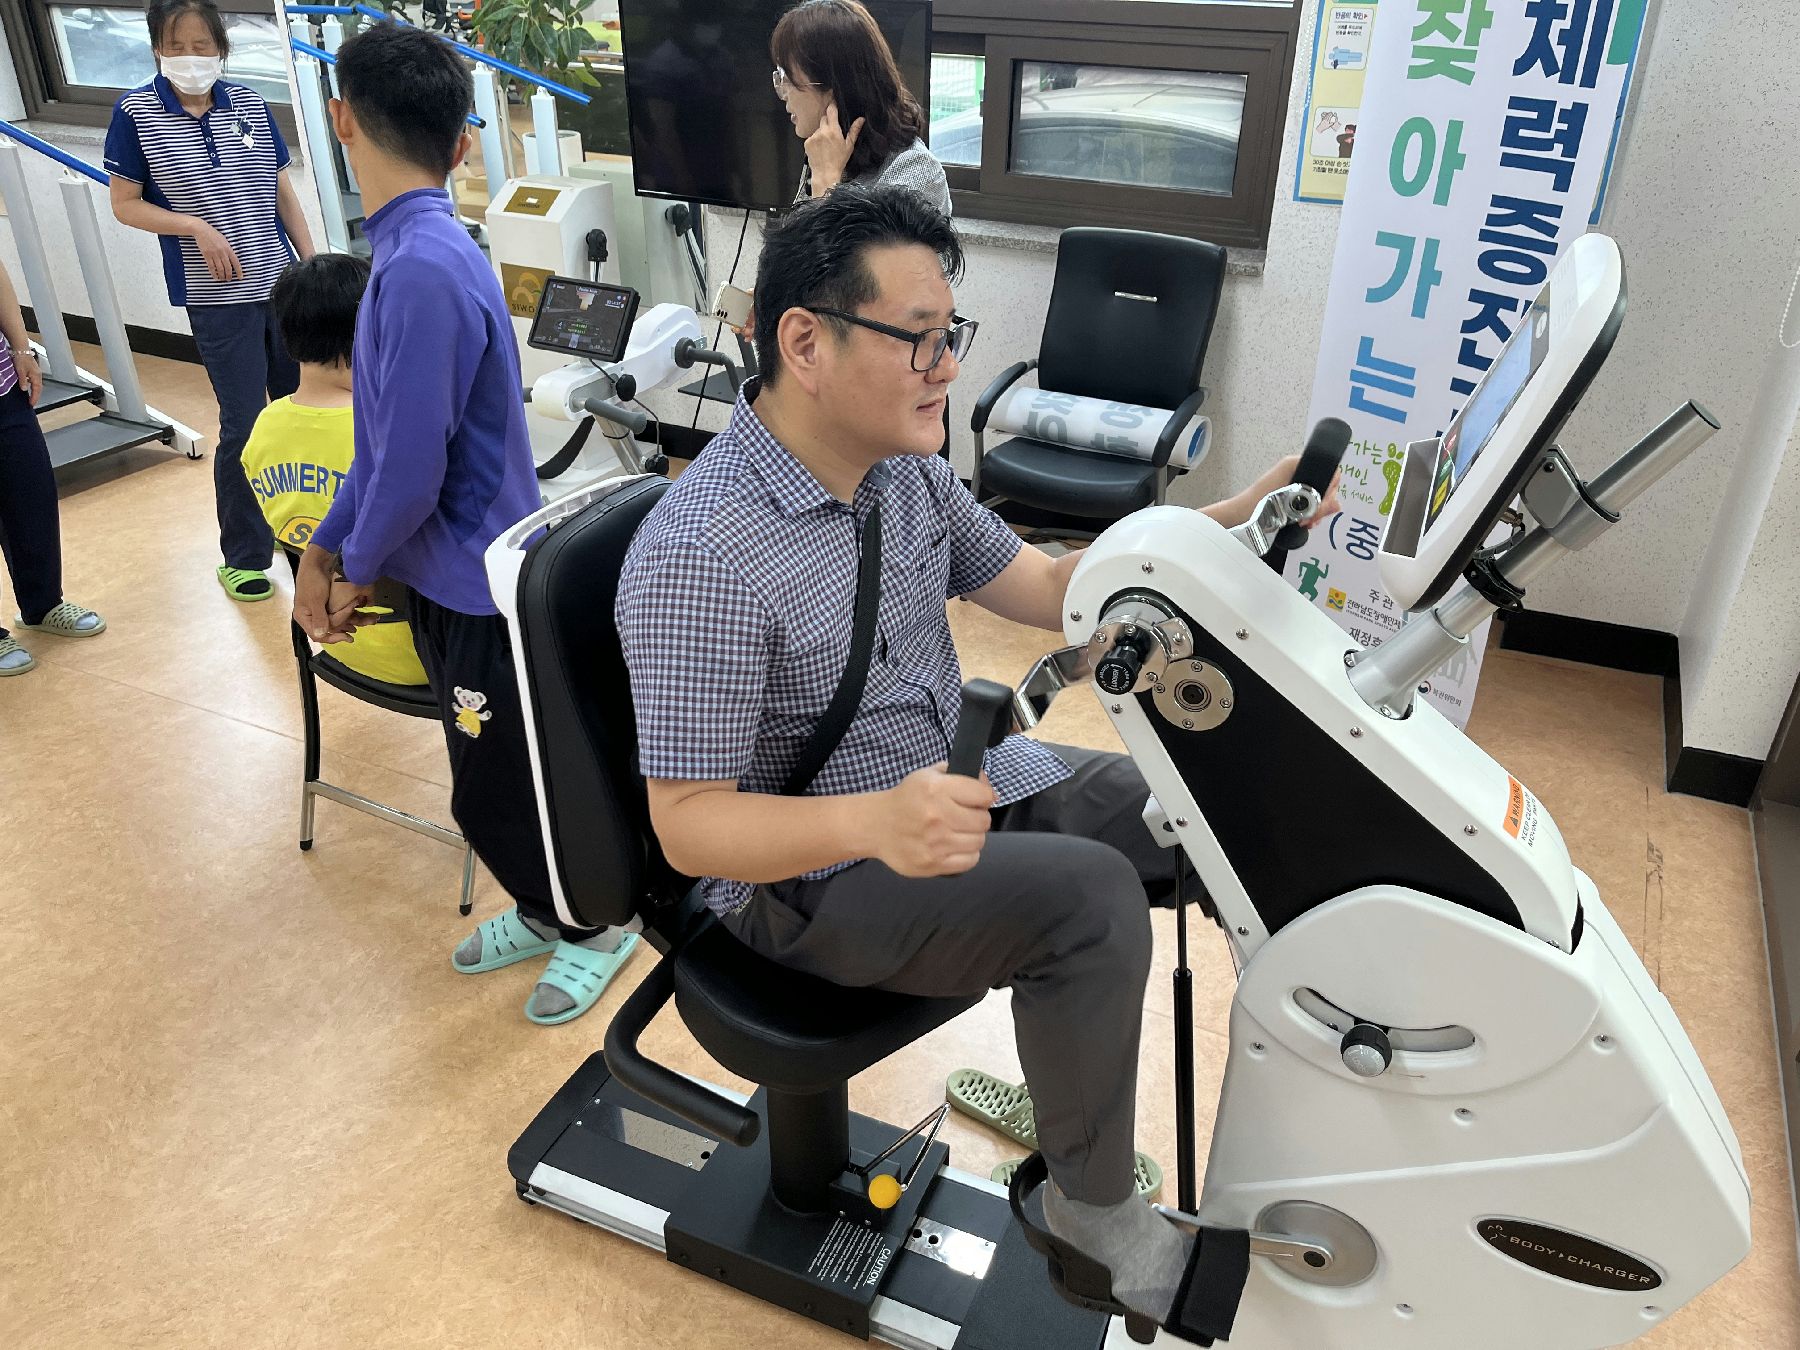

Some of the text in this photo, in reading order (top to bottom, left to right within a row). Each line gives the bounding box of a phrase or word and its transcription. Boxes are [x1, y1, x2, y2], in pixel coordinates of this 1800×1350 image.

[1347, 0, 1494, 424] 찾아가는
[866, 1247, 892, 1286] CAUTION
[1509, 1236, 1652, 1285] BODY CHARGER
